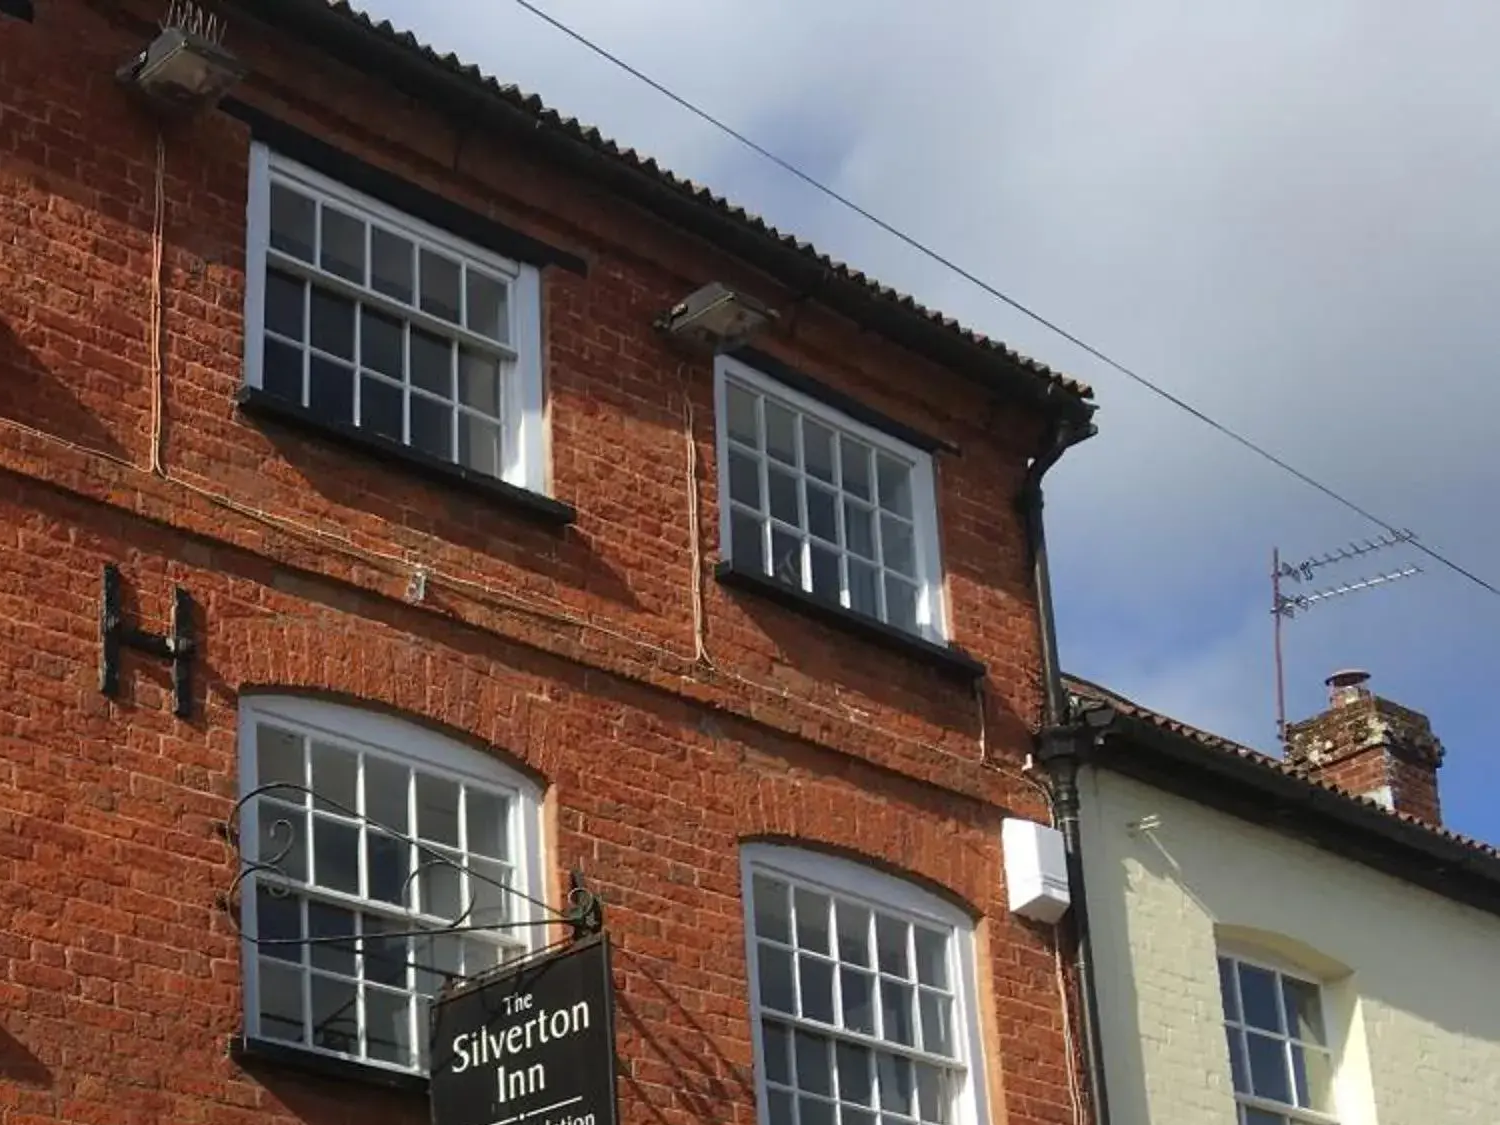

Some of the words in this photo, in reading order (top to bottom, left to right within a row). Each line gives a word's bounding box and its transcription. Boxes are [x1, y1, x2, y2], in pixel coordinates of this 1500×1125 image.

[503, 991, 533, 1017] The
[451, 1000, 590, 1074] Silverton
[497, 1062, 546, 1104] Inn
